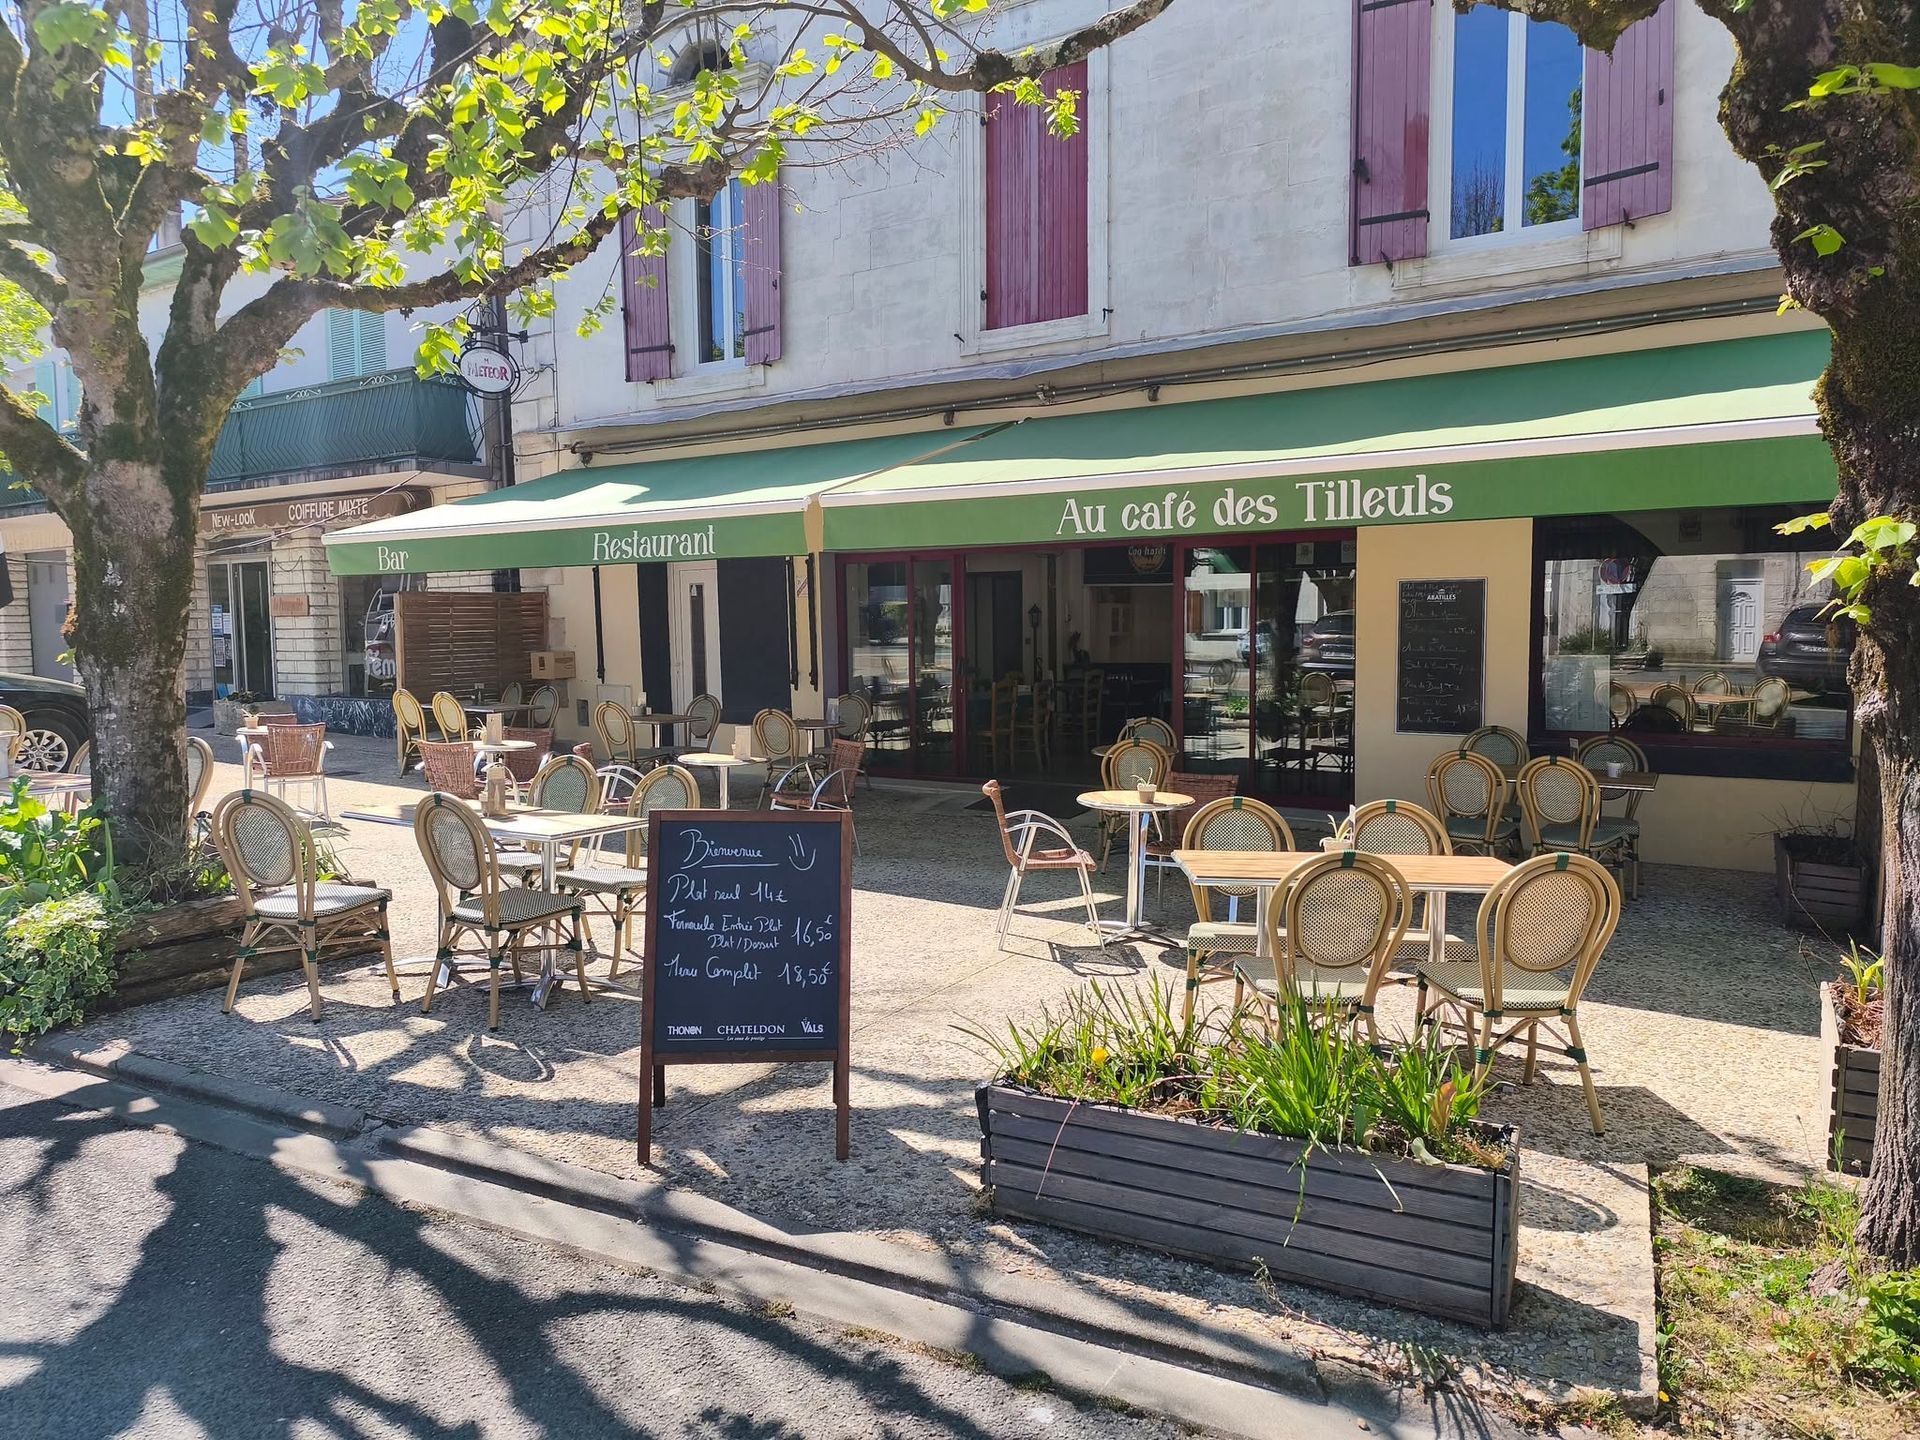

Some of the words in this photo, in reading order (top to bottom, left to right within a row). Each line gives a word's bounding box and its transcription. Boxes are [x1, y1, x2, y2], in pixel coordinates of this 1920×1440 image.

[288, 501, 335, 521] COIFFURE
[338, 498, 369, 516] MIXTE
[1056, 498, 1106, 535] Au
[1121, 490, 1197, 530] café
[1213, 488, 1278, 527] des
[1295, 474, 1454, 522] Tilleuls
[592, 524, 716, 561] Restaurant
[377, 546, 409, 571] Bar
[679, 829, 763, 870] Bienvenue
[667, 873, 707, 903] Plat
[714, 883, 741, 901] seul
[750, 881, 788, 903] 14€
[663, 909, 715, 931] Formule
[754, 915, 783, 933] Plat
[664, 954, 698, 977] Menu
[705, 956, 762, 987] Complet
[667, 1025, 702, 1035] THONON
[717, 1024, 785, 1035] CHATELDON
[801, 1021, 824, 1033] VALS
